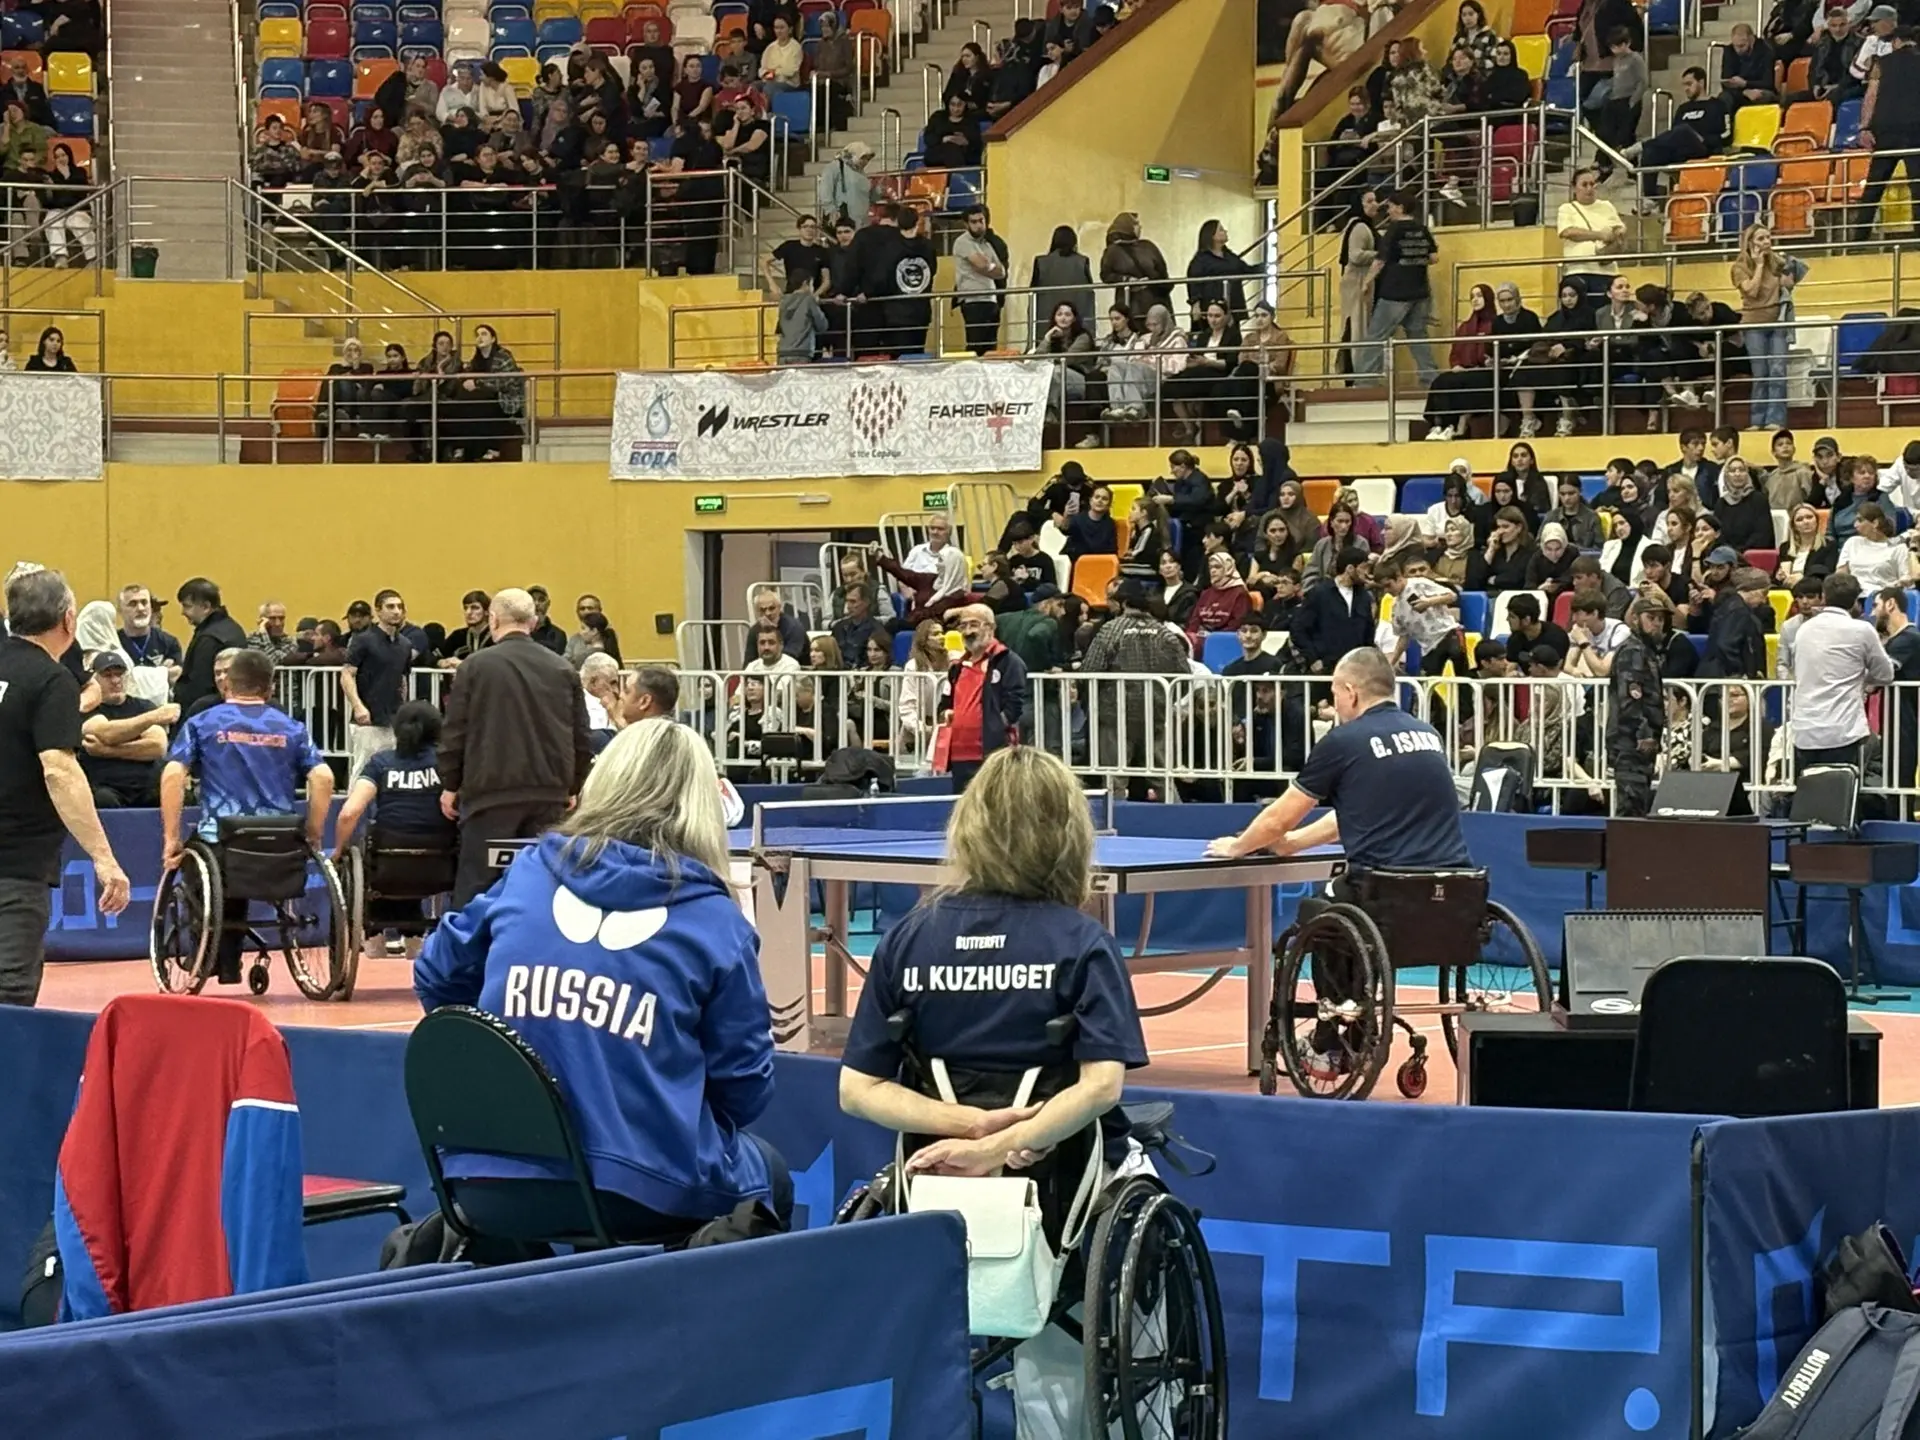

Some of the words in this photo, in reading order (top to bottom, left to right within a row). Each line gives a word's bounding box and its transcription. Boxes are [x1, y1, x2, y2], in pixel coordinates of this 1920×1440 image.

[929, 402, 1034, 419] FAHRENHEIT
[733, 413, 830, 433] WRESTLER
[387, 767, 441, 789] PLIEVA
[956, 935, 1007, 950] BUTTERFLY
[903, 966, 923, 992] U.
[929, 963, 1056, 991] KUZHUGET
[504, 965, 657, 1047] RUSSIA
[1781, 1348, 1831, 1410] BUTTERFLY
